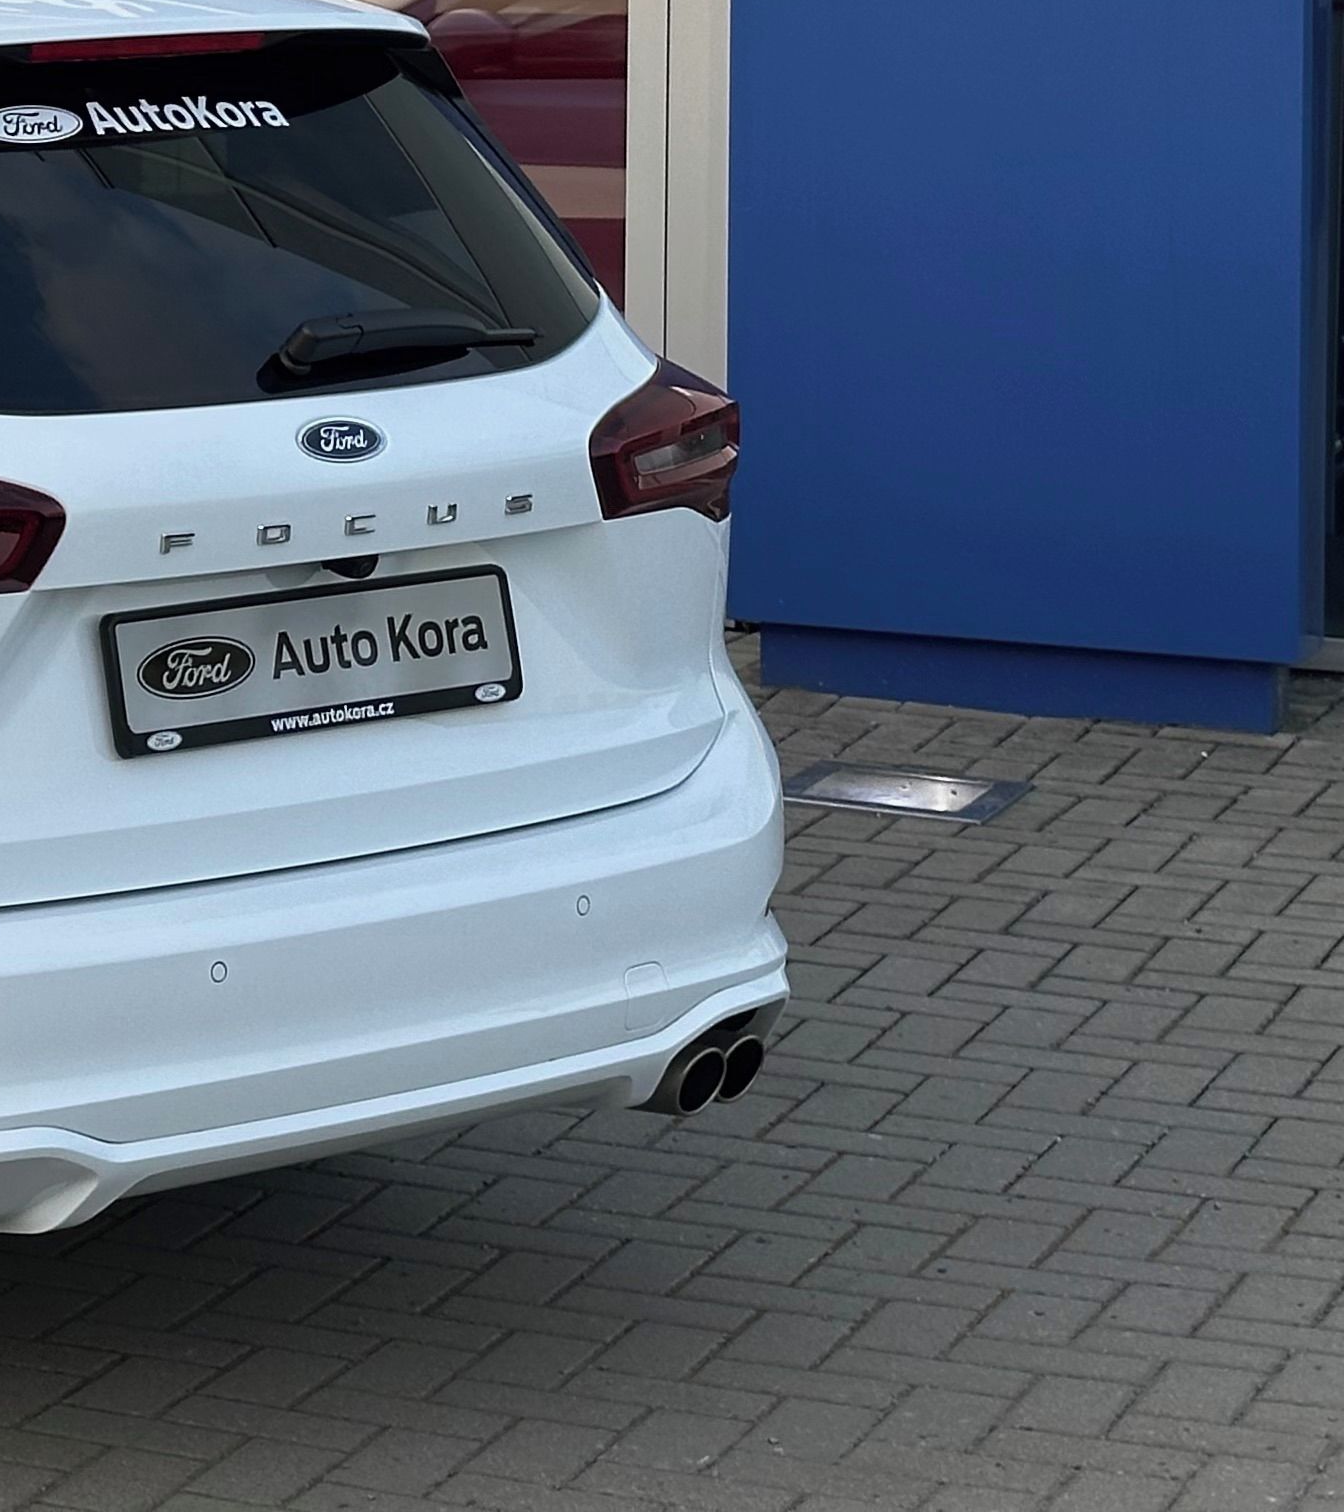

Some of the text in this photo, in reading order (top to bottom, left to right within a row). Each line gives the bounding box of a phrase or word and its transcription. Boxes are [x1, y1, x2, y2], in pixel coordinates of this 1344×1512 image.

[86, 95, 290, 136] AutoKora
[160, 494, 533, 554] FOCUS
[273, 624, 379, 680] Auto
[387, 613, 489, 663] Kora
[271, 701, 395, 732] www.autokora.cz
